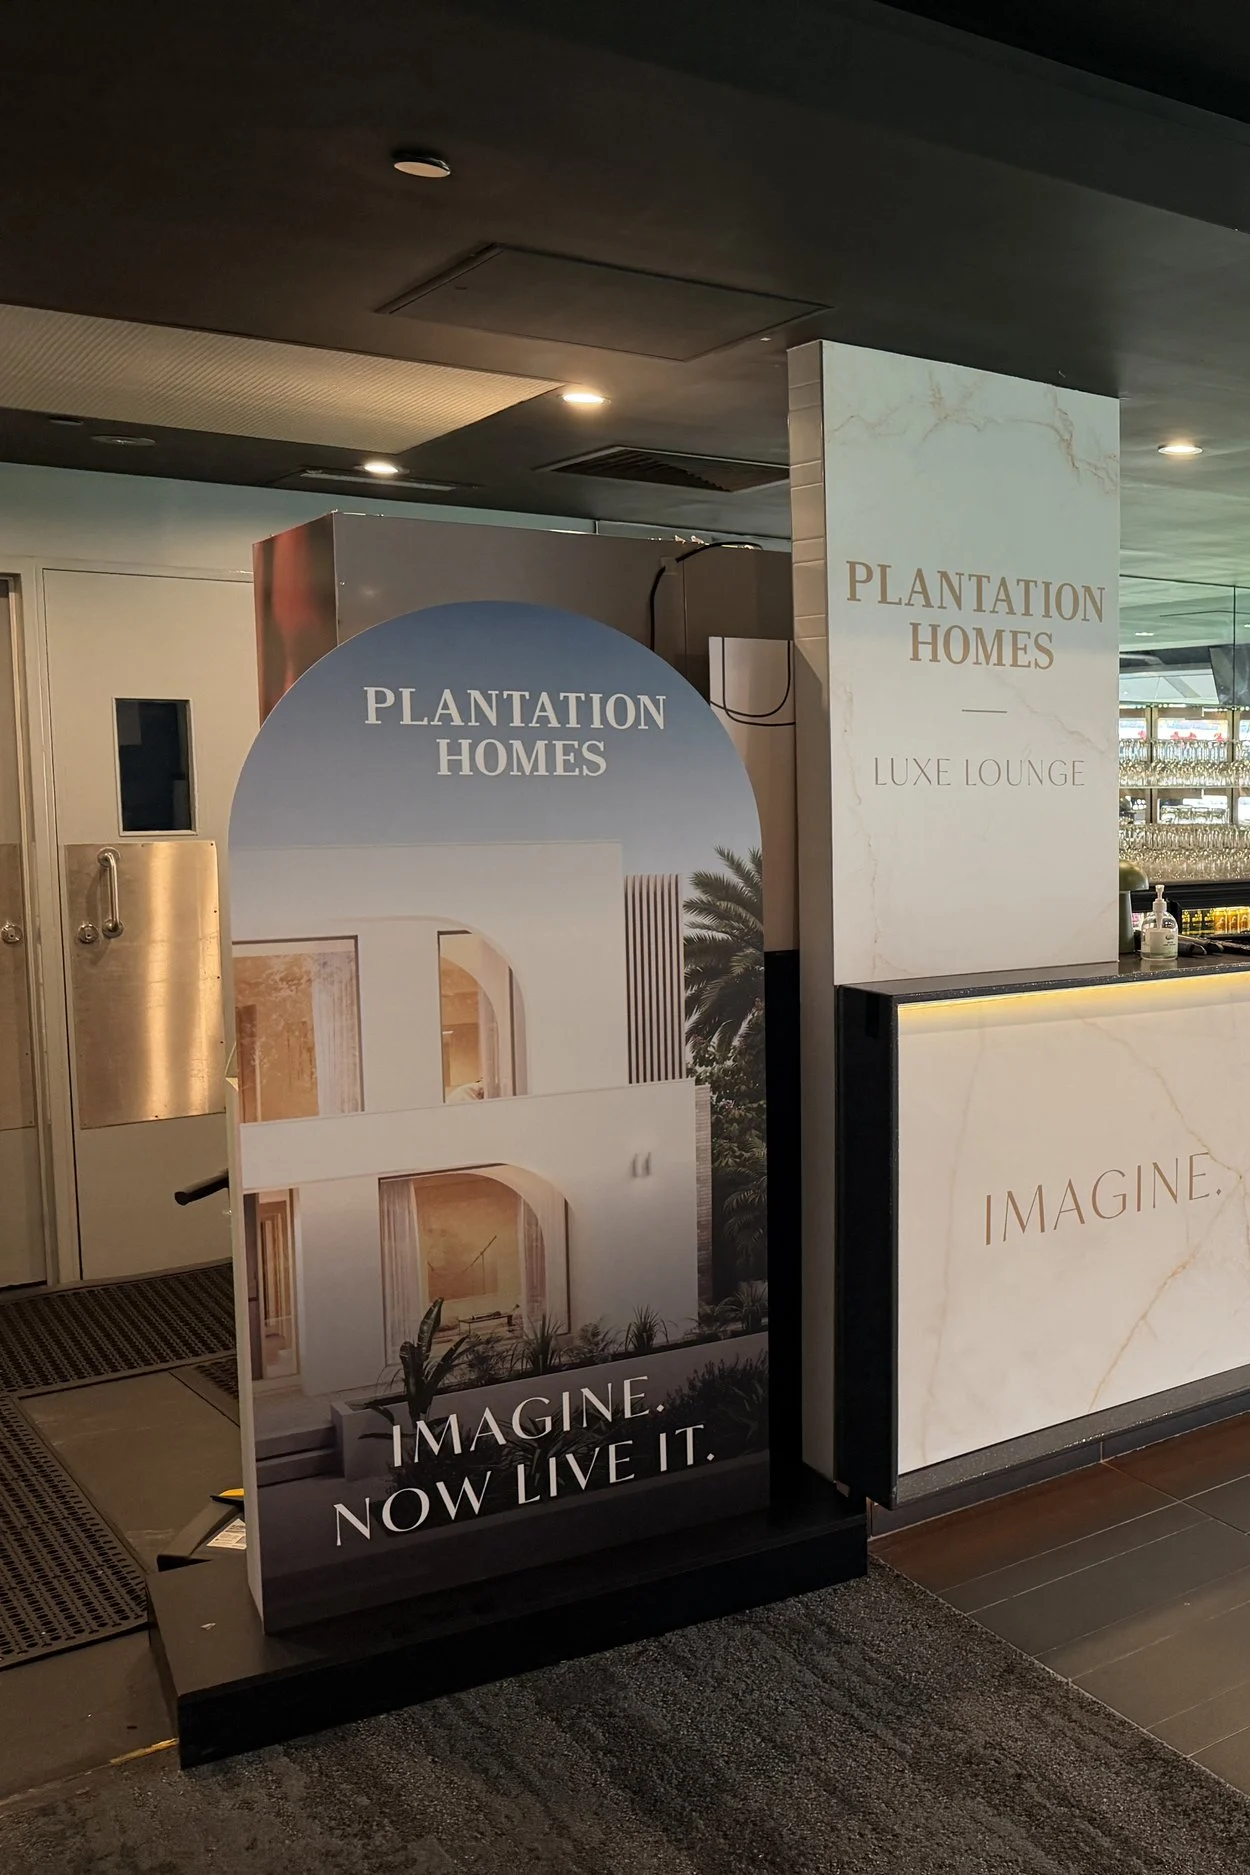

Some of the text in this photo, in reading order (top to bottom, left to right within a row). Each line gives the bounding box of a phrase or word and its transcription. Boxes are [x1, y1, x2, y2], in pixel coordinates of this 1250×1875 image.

[845, 560, 1106, 624] PLANTATION
[908, 621, 1055, 671] HOMES
[363, 686, 667, 731] PLANTATION
[435, 738, 608, 777] HOMES
[874, 756, 1087, 788] LUXE LOUNGE
[985, 1151, 1223, 1247] IMAGINE.
[391, 1375, 666, 1468] IMAGINE.
[333, 1424, 716, 1547] NOW LIVE IT.
